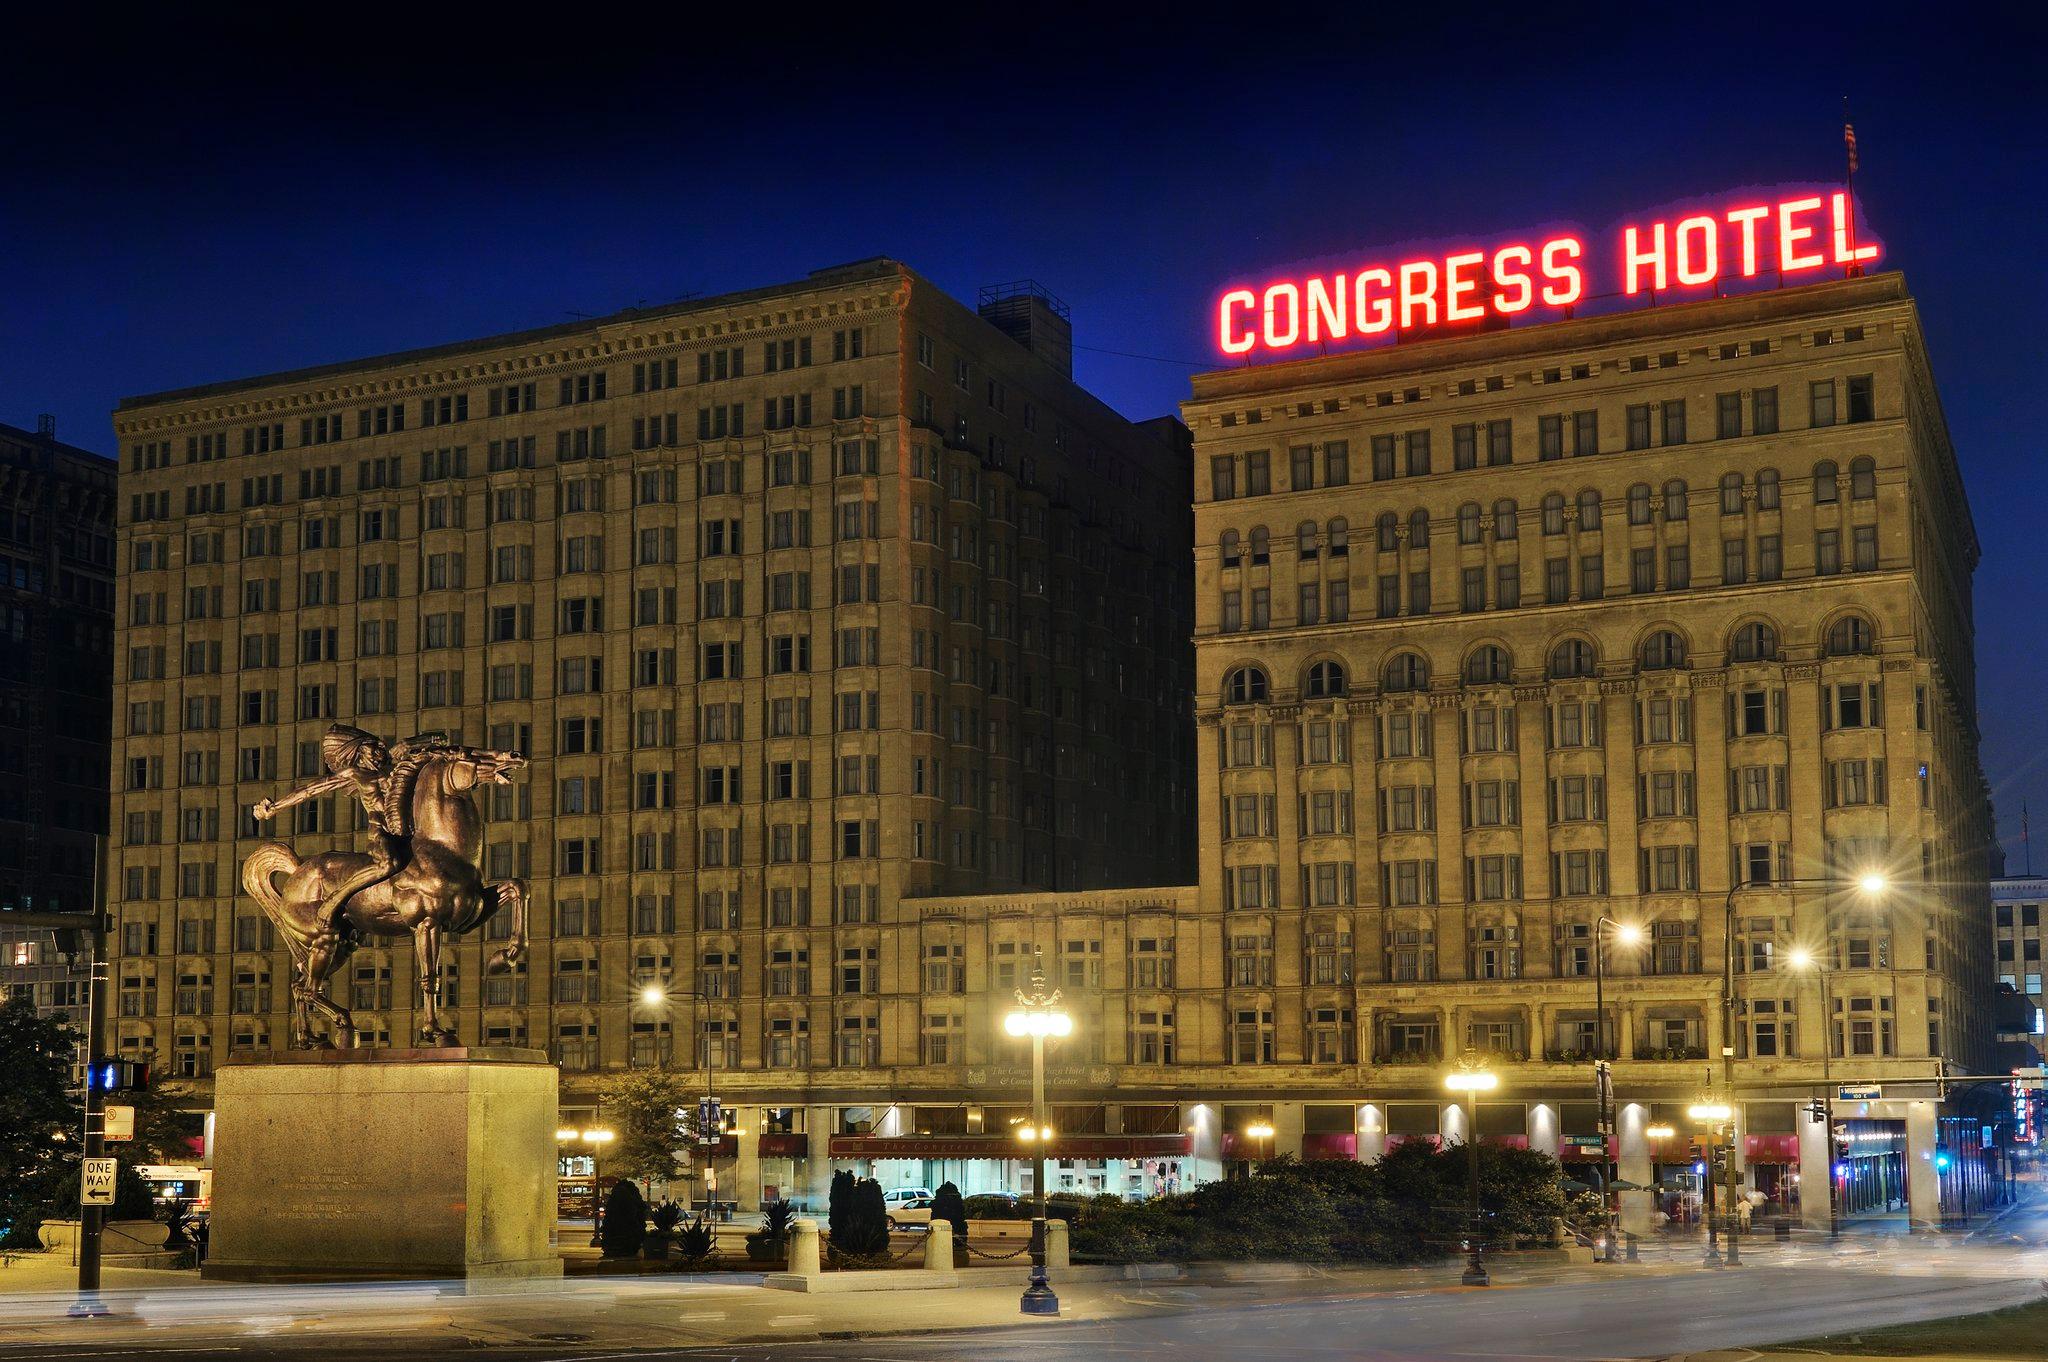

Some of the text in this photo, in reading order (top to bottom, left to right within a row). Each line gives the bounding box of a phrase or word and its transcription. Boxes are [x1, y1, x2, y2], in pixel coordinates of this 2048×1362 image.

[1219, 191, 1879, 354] CONGRESS HOTEL
[1000, 1077, 1008, 1085] &
[1053, 1076, 1079, 1085] Center
[883, 1142, 906, 1150] The
[88, 1162, 112, 1173] ONE
[86, 1175, 111, 1186] WAY
